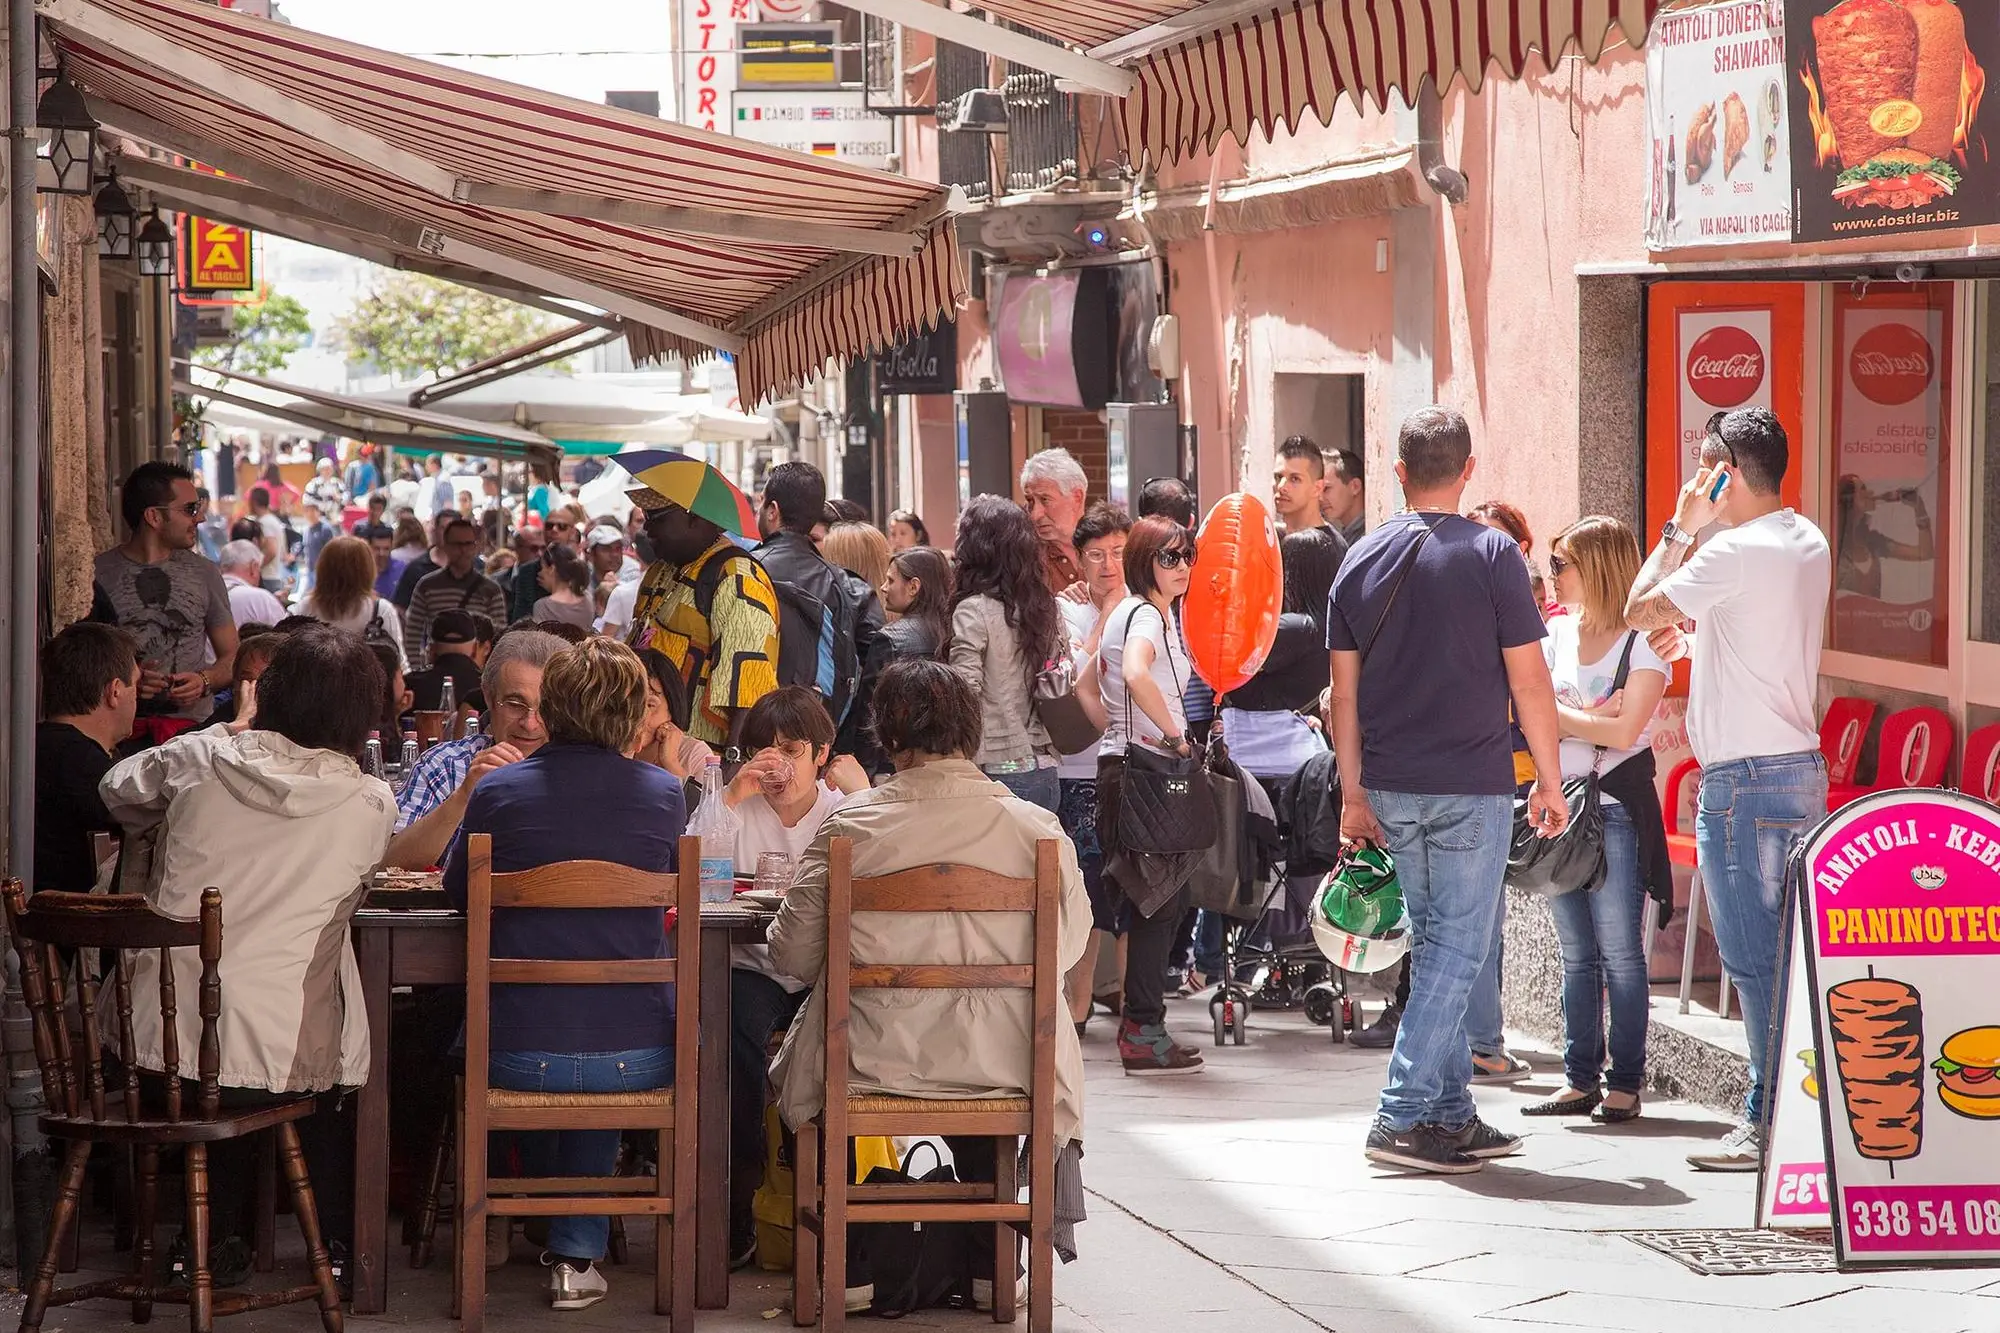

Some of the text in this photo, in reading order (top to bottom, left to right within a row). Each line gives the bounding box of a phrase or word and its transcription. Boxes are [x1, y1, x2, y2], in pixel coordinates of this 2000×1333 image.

[1660, 12, 1712, 47] ANATOLI
[1714, 36, 1786, 73] SHAWARM
[764, 107, 804, 121] CAMBIO
[841, 142, 888, 156] WECHSEL
[1700, 213, 1791, 235] VIA NAPOLI 18 CAGLI
[1832, 209, 1960, 232] www.dostlar.biz
[1691, 352, 1760, 380] Coca-Cola
[1816, 819, 1919, 896] ANATOLI
[1916, 869, 1942, 880] حلال
[1826, 905, 2000, 944] PANINOTEC
[1852, 1199, 2000, 1237] 338 54 08
